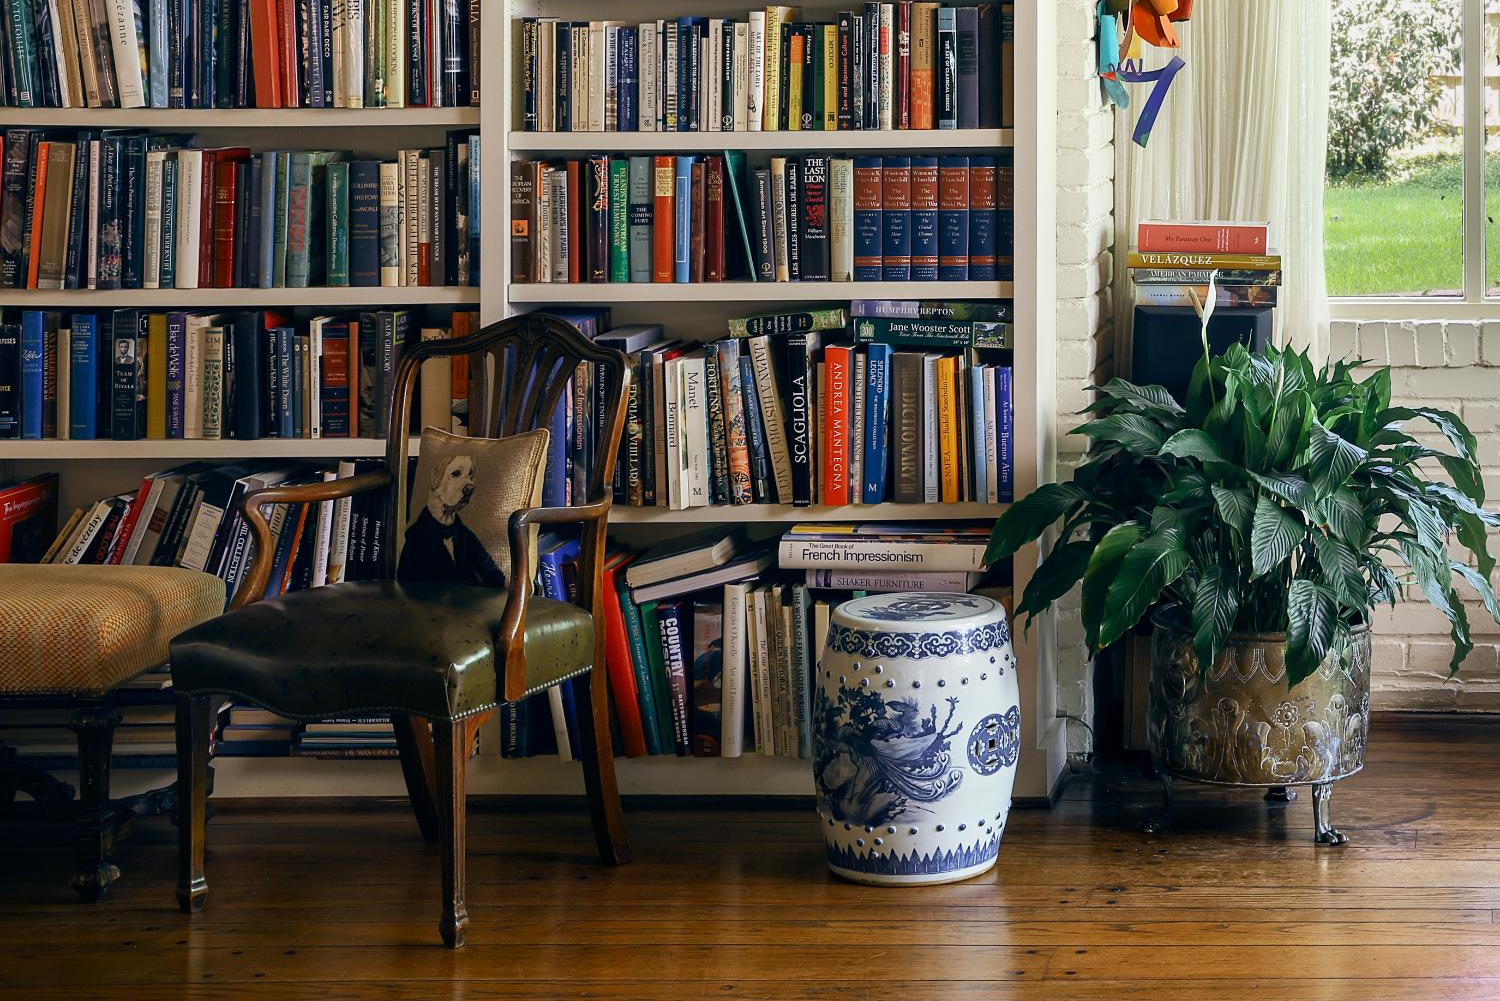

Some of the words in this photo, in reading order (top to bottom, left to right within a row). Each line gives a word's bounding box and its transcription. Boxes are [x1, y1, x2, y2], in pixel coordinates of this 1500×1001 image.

[12, 10, 21, 21] TO
[12, 22, 25, 59] FOLLIES
[804, 167, 825, 175] LAST
[804, 175, 825, 183] LION
[542, 172, 550, 196] Dylan
[620, 199, 626, 207] IN
[560, 227, 566, 236] IN
[1142, 254, 1212, 266] VELÁZQUEZ
[169, 324, 179, 342] Elsie
[889, 323, 909, 332] Jane
[911, 323, 946, 332] Wooster
[949, 325, 971, 333] Scott
[169, 343, 179, 353] de
[168, 354, 179, 378] Wolfe
[281, 353, 289, 367] The
[752, 343, 769, 382] JAPAN
[281, 367, 289, 388] White
[577, 366, 585, 386] Faces
[577, 388, 585, 396] of
[688, 371, 699, 409] Manet
[707, 364, 718, 413] FORTUNY
[761, 384, 770, 392] A
[833, 363, 842, 413] ANDREA
[628, 384, 638, 434] EDOUARD
[792, 376, 807, 463] SCAGLIOLA
[576, 397, 585, 450] Impressionism
[762, 396, 782, 446] HISTORY
[902, 392, 916, 480] DICTIONARY
[629, 435, 638, 487] VUILLARD
[775, 451, 785, 464] IN
[833, 419, 842, 490] MANTEGNA
[779, 467, 790, 490] ART
[226, 536, 245, 584] COLLECTION
[802, 548, 842, 562] French
[844, 549, 923, 564] Impressionism
[836, 578, 870, 588] SHAKER
[874, 579, 925, 589] FURNITURE
[794, 607, 802, 630] WORK
[665, 618, 683, 677] COUNTRY
[776, 631, 784, 659] QUEEN
[795, 631, 802, 641] OF
[659, 620, 671, 679] MUSIC
[778, 660, 786, 691] VICTORIA
